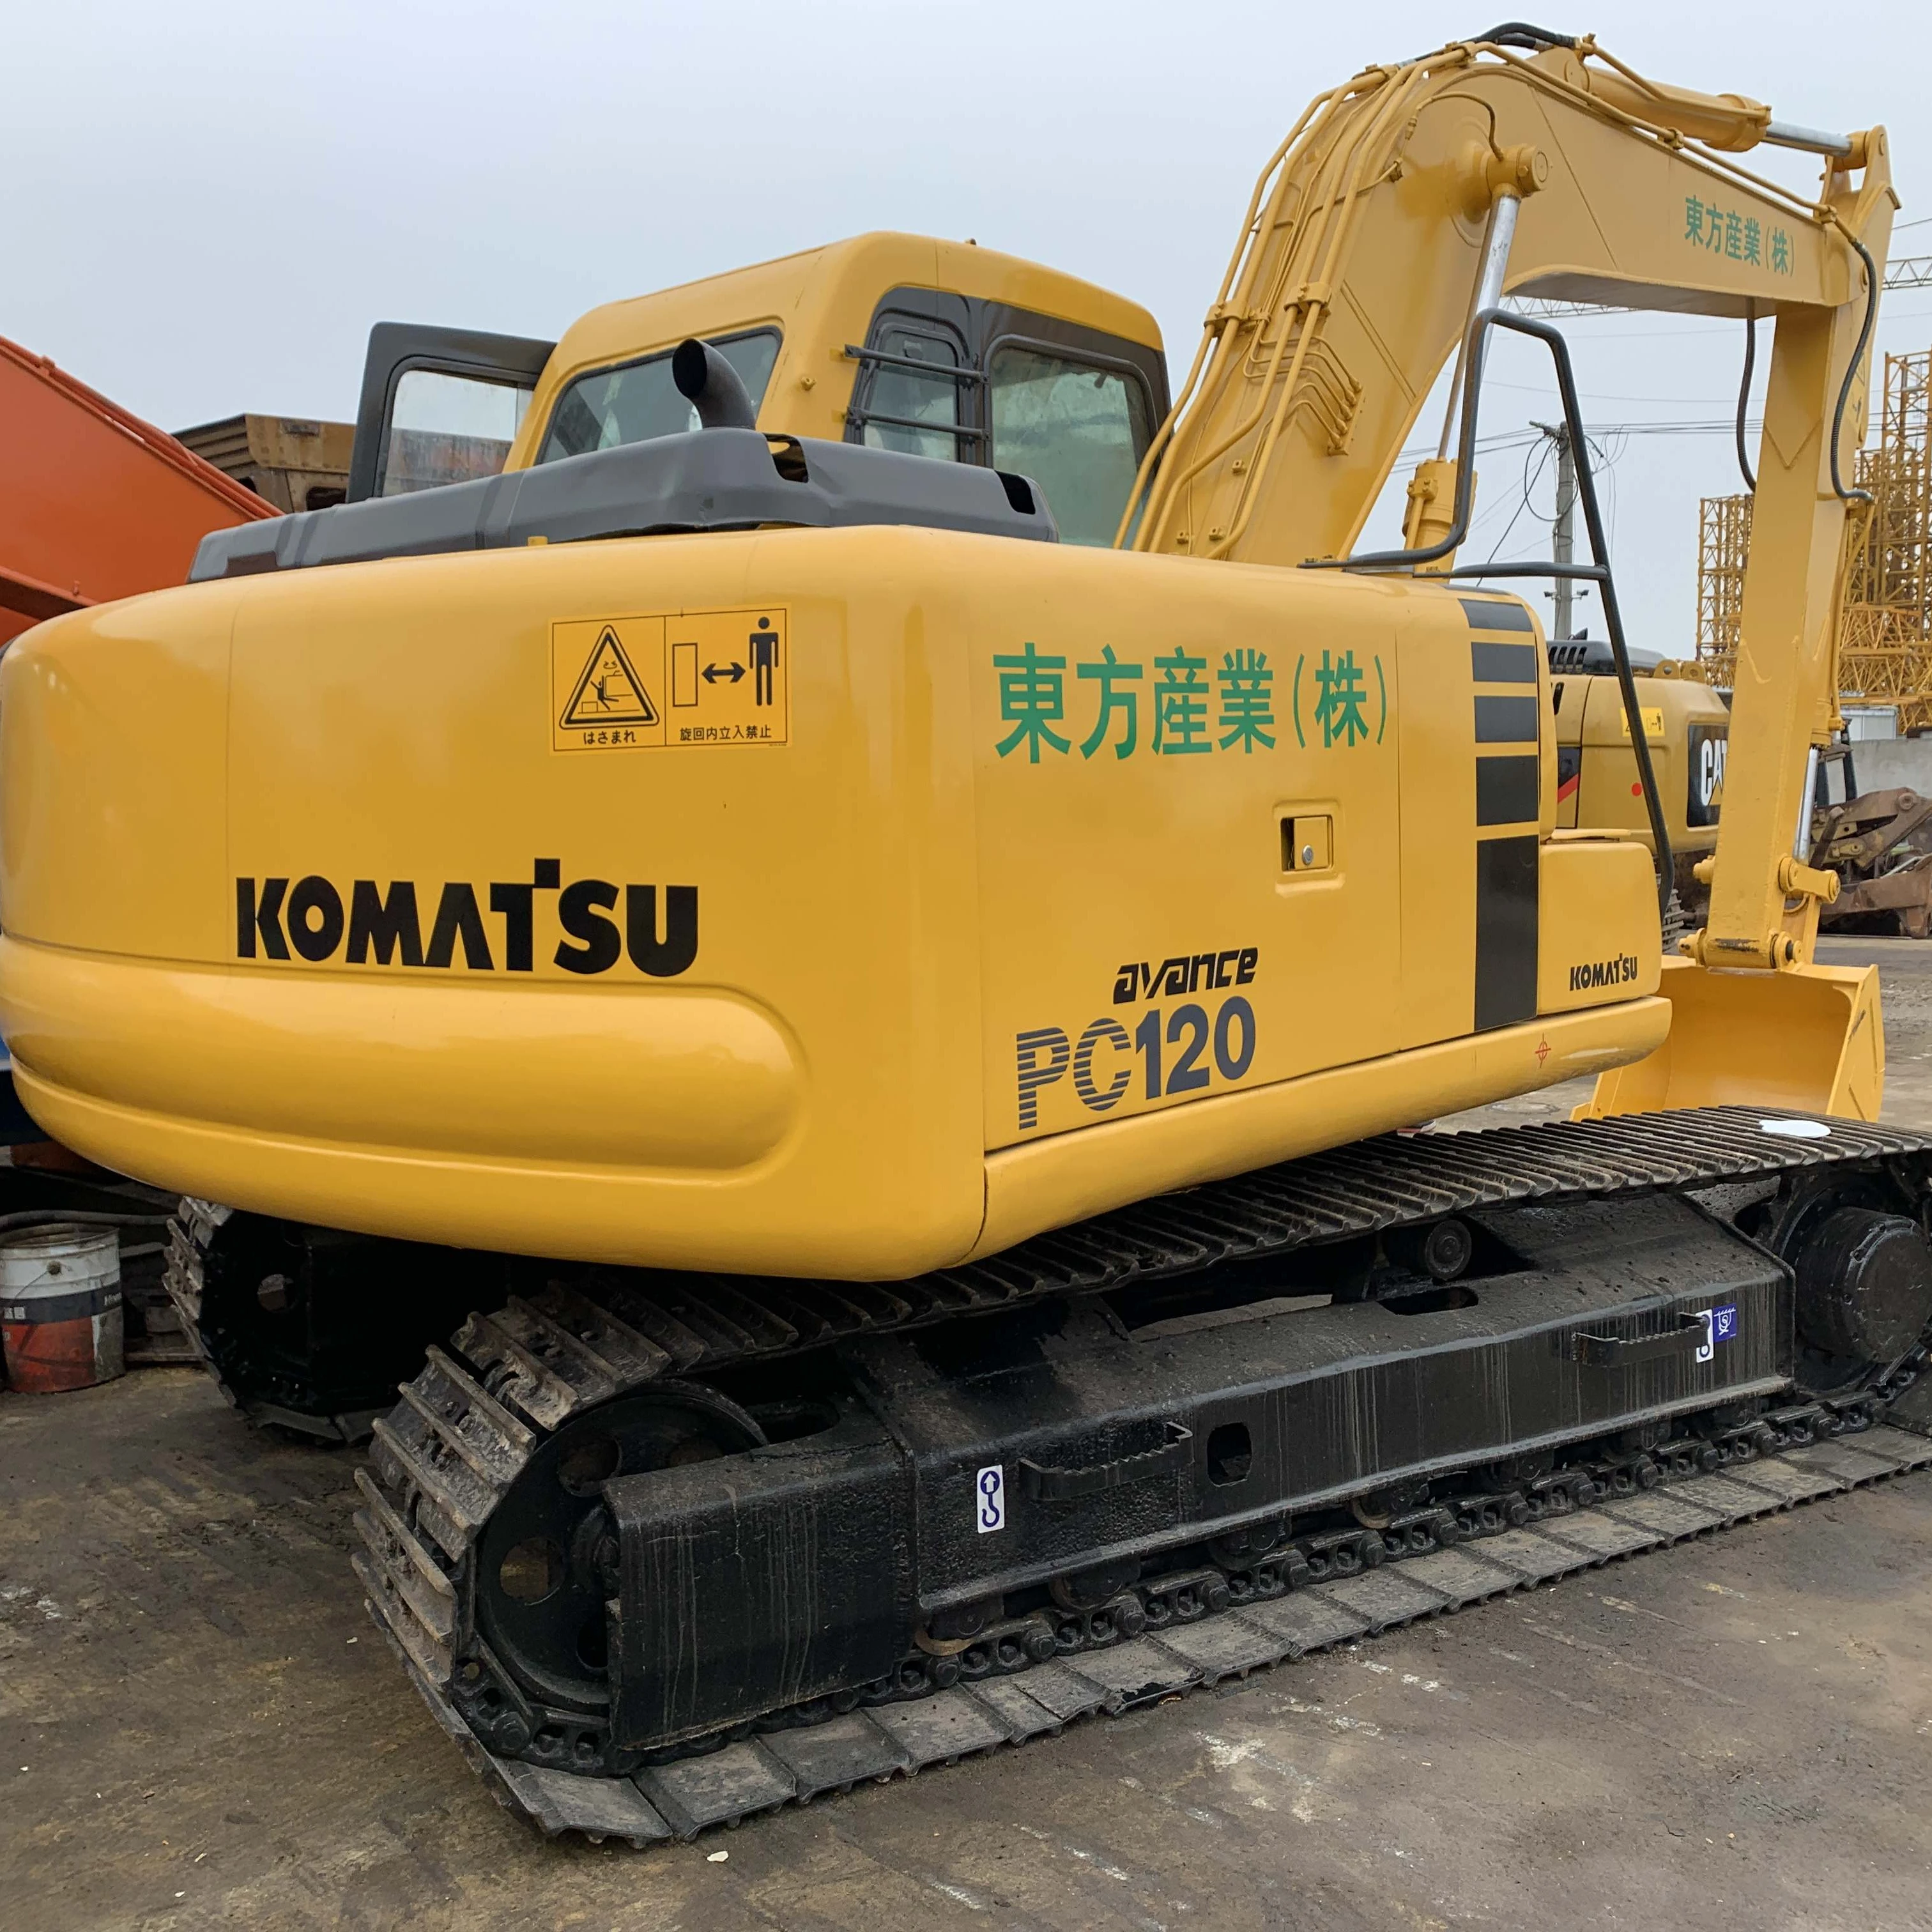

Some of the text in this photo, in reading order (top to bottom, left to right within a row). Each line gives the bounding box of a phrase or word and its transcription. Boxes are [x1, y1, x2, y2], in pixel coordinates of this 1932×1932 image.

[583, 730, 636, 744] はさまれ
[680, 724, 771, 741] 旋回内立入禁止
[236, 857, 698, 977] KOMATSU
[1113, 947, 1258, 1004] avance
[1570, 953, 1638, 991] KOMATSU
[1016, 995, 1255, 1130] PC120
